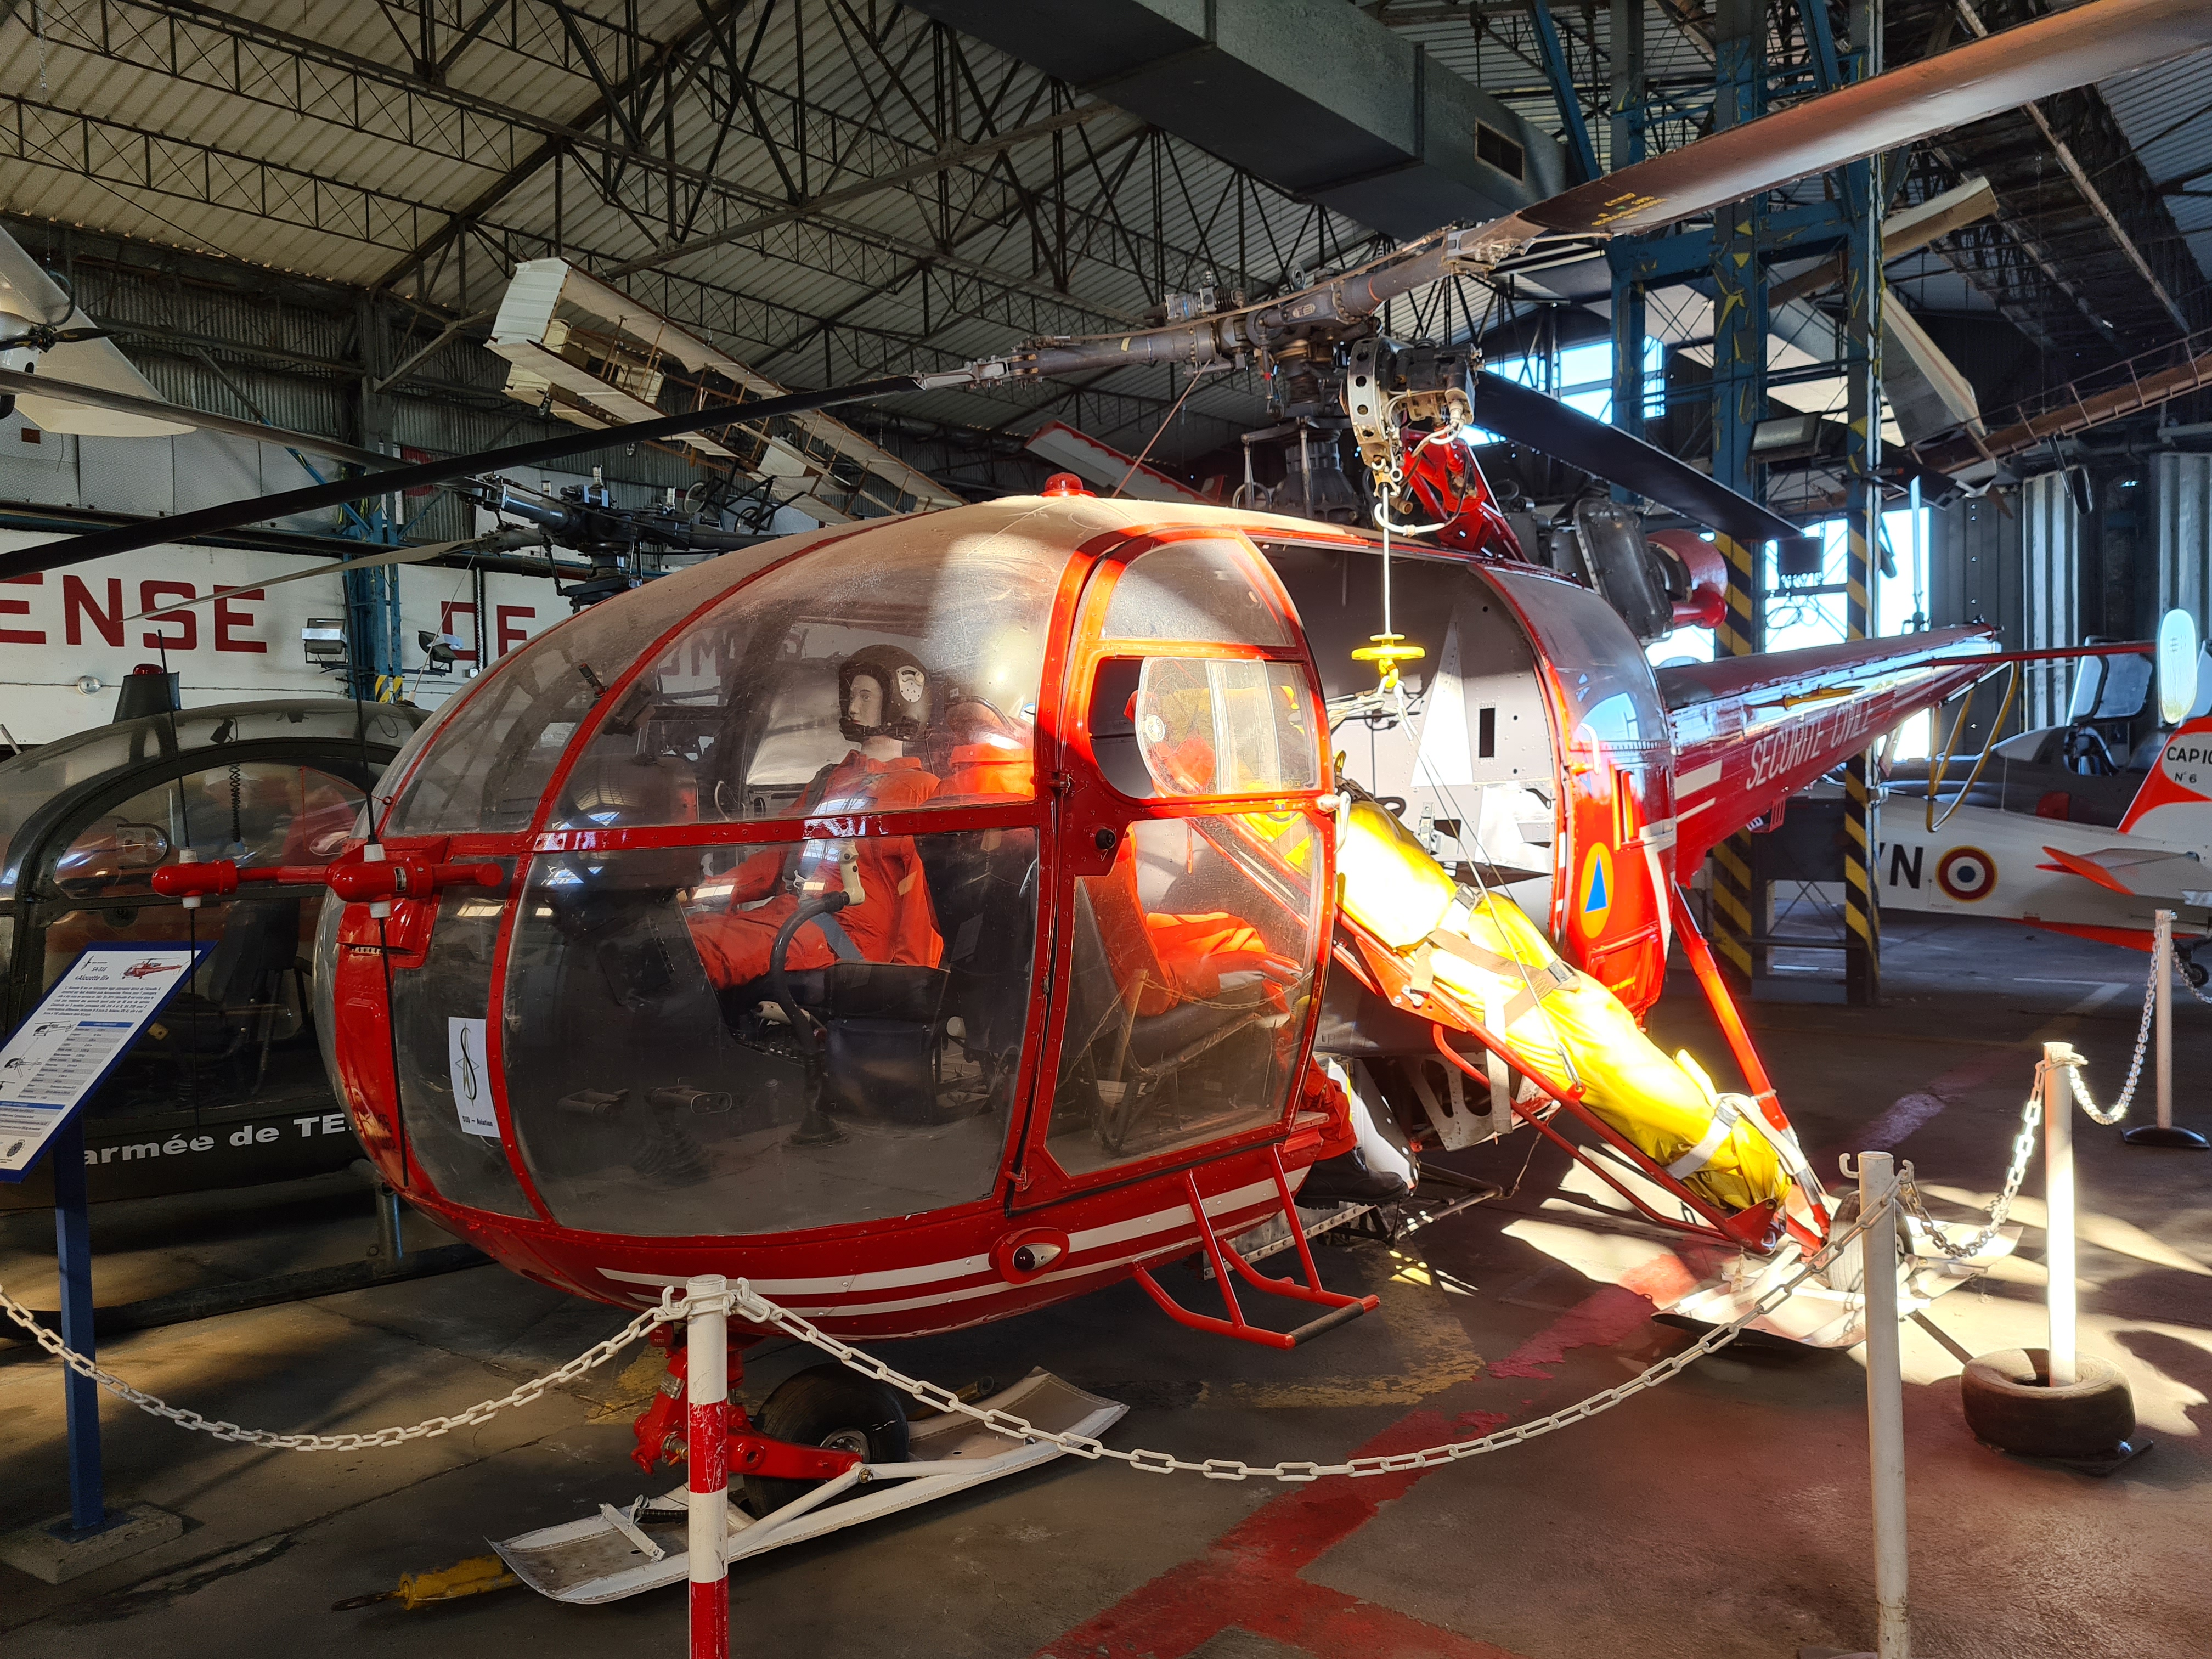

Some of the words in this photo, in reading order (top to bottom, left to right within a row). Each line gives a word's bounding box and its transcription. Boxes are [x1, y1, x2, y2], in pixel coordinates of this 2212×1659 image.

[477, 1118, 493, 1127] Aviation
[84, 1133, 215, 1165] armée
[229, 1125, 280, 1147] de
[294, 1113, 352, 1137] TE
